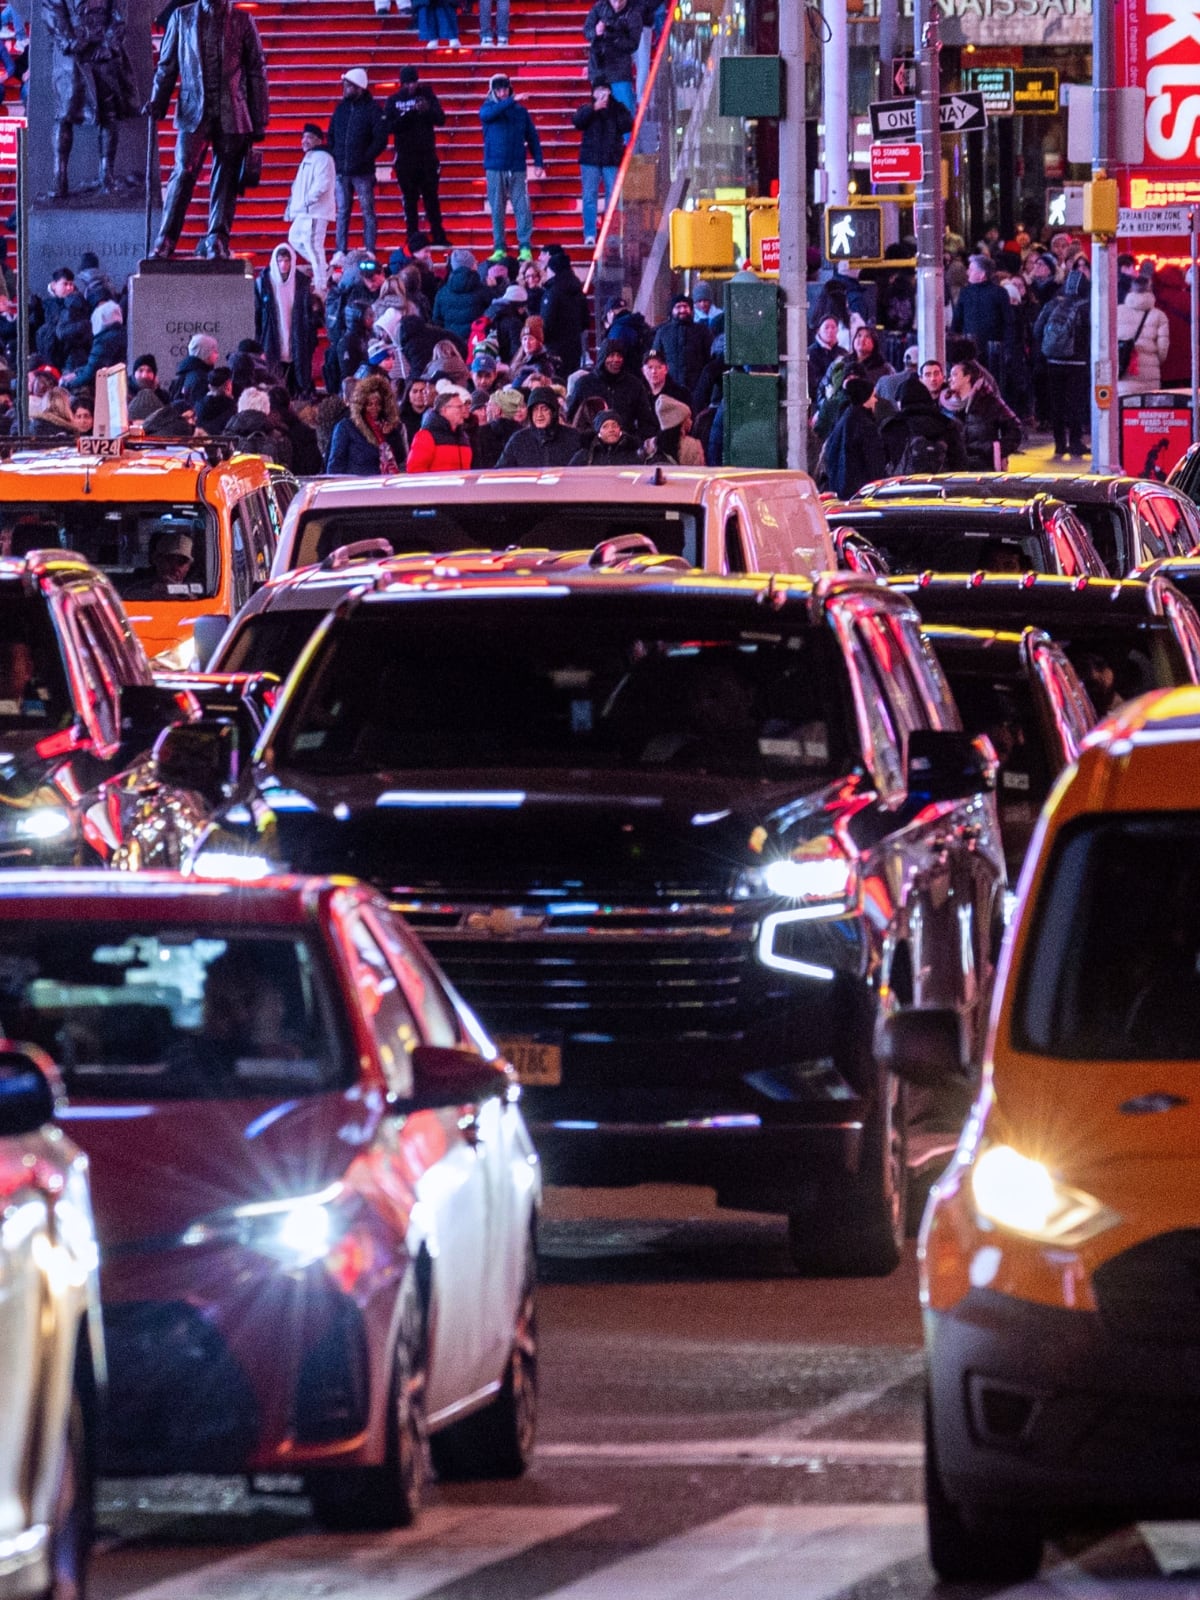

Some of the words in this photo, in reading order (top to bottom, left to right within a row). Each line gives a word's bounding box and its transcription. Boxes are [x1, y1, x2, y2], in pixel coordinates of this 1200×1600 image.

[872, 148, 881, 157] NO
[882, 147, 910, 157] STANDING
[873, 157, 897, 166] Anytime
[165, 321, 221, 334] GEORGE
[81, 440, 118, 455] 2V24
